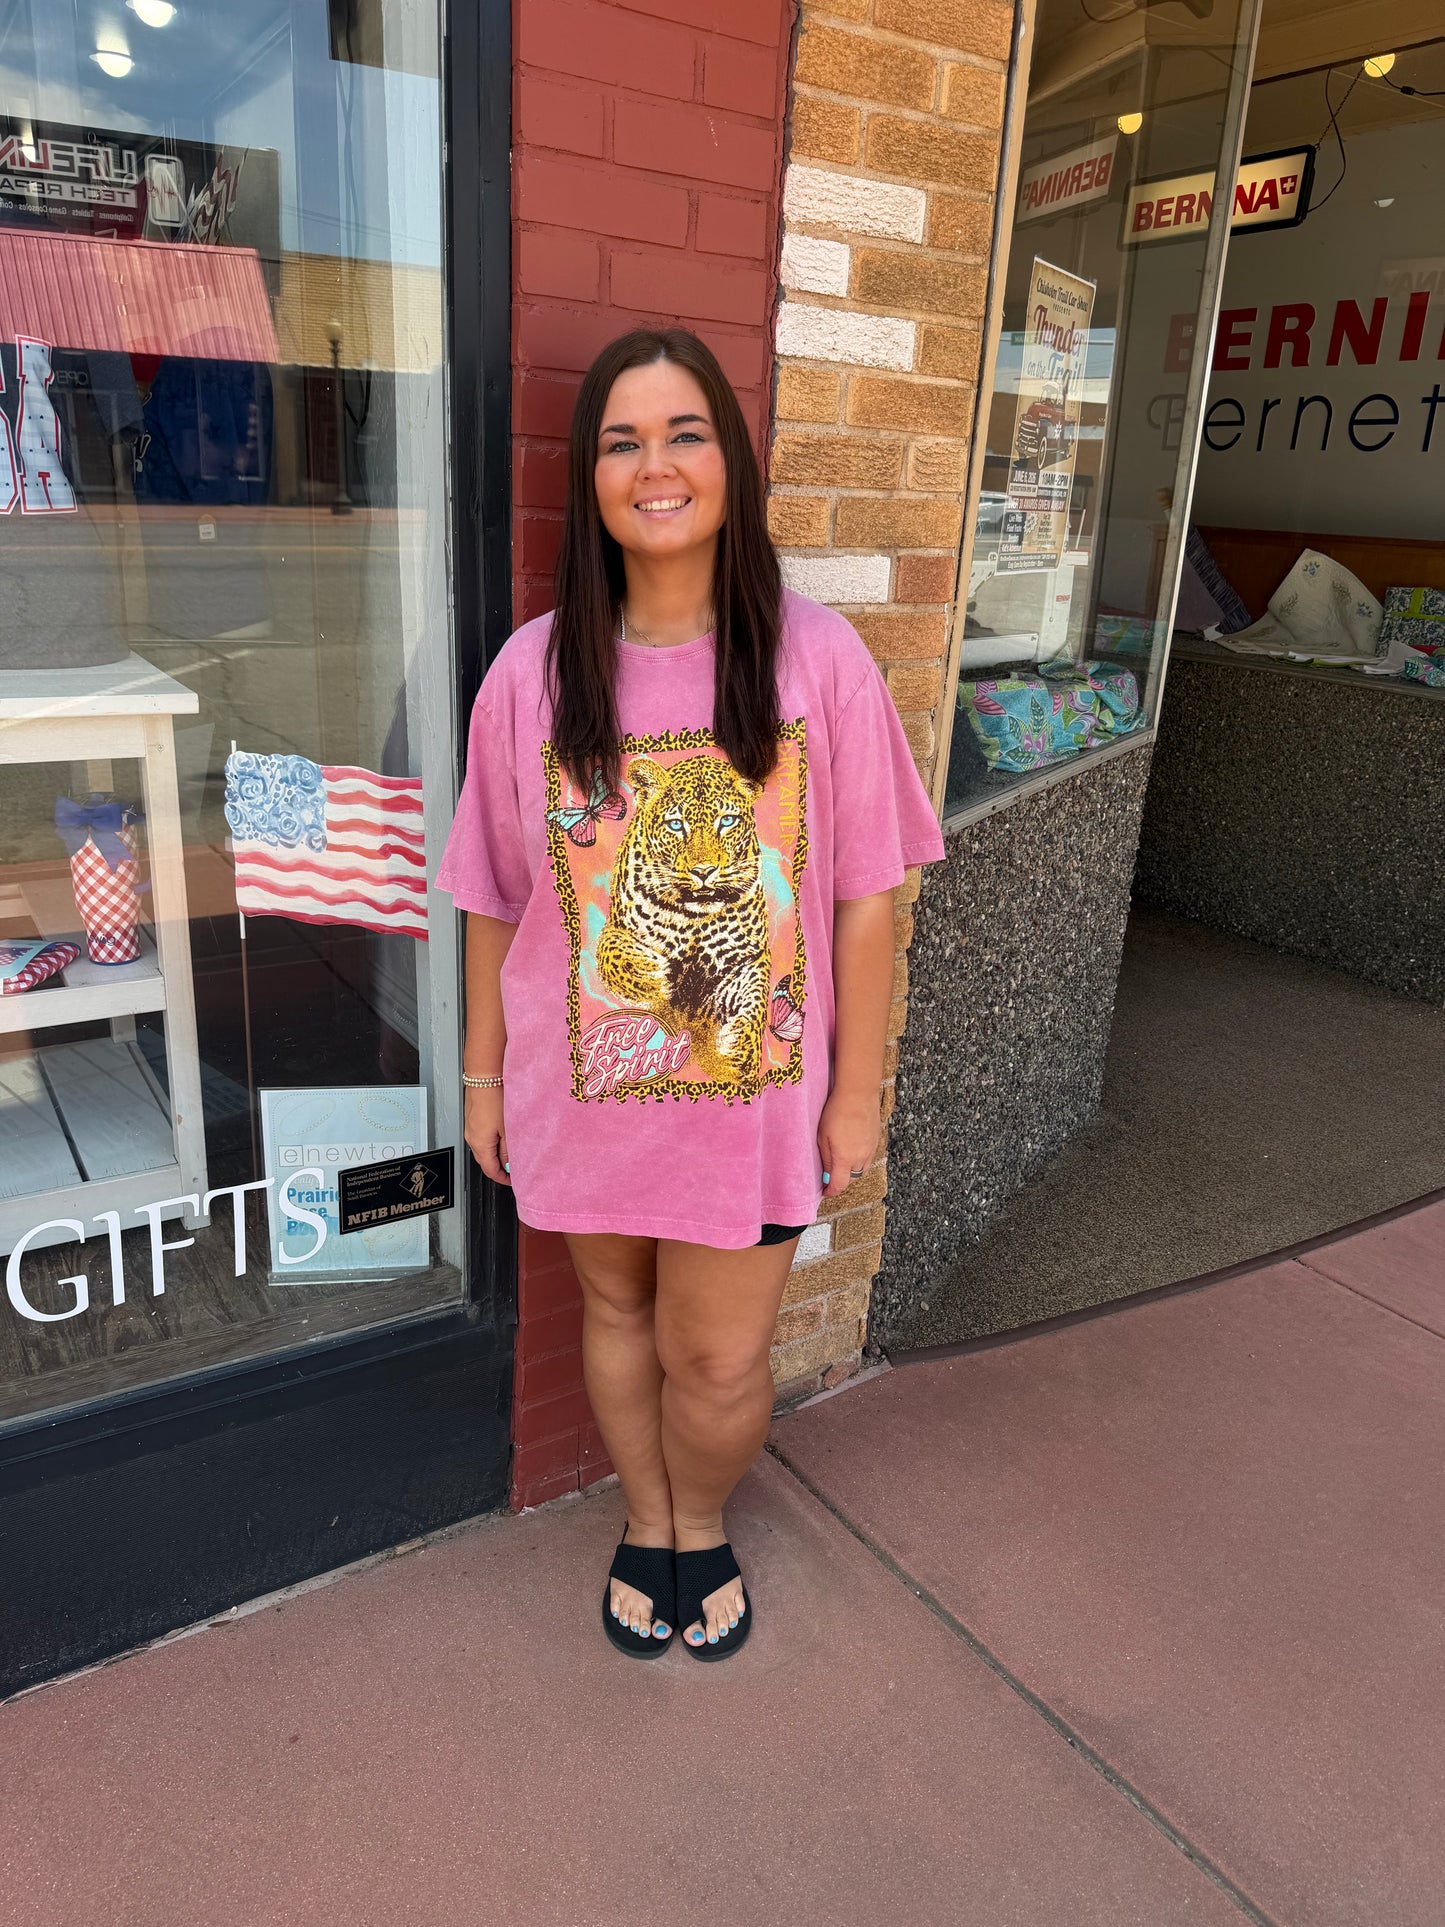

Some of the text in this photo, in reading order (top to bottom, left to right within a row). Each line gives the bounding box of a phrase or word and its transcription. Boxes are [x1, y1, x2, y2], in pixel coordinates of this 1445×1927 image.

[1132, 178, 1280, 232] BERNNA
[1033, 304, 1085, 357] Thunder
[1163, 288, 1445, 373] BERNI
[1047, 352, 1082, 396] Trail
[775, 742, 798, 848] DREAMER
[578, 1016, 658, 1075] Free
[583, 1030, 690, 1098] Spirit
[346, 1176, 379, 1187] Independent
[347, 1207, 389, 1226] NFIB
[390, 1195, 446, 1216] Member
[6, 1167, 328, 1322] GIFTS
